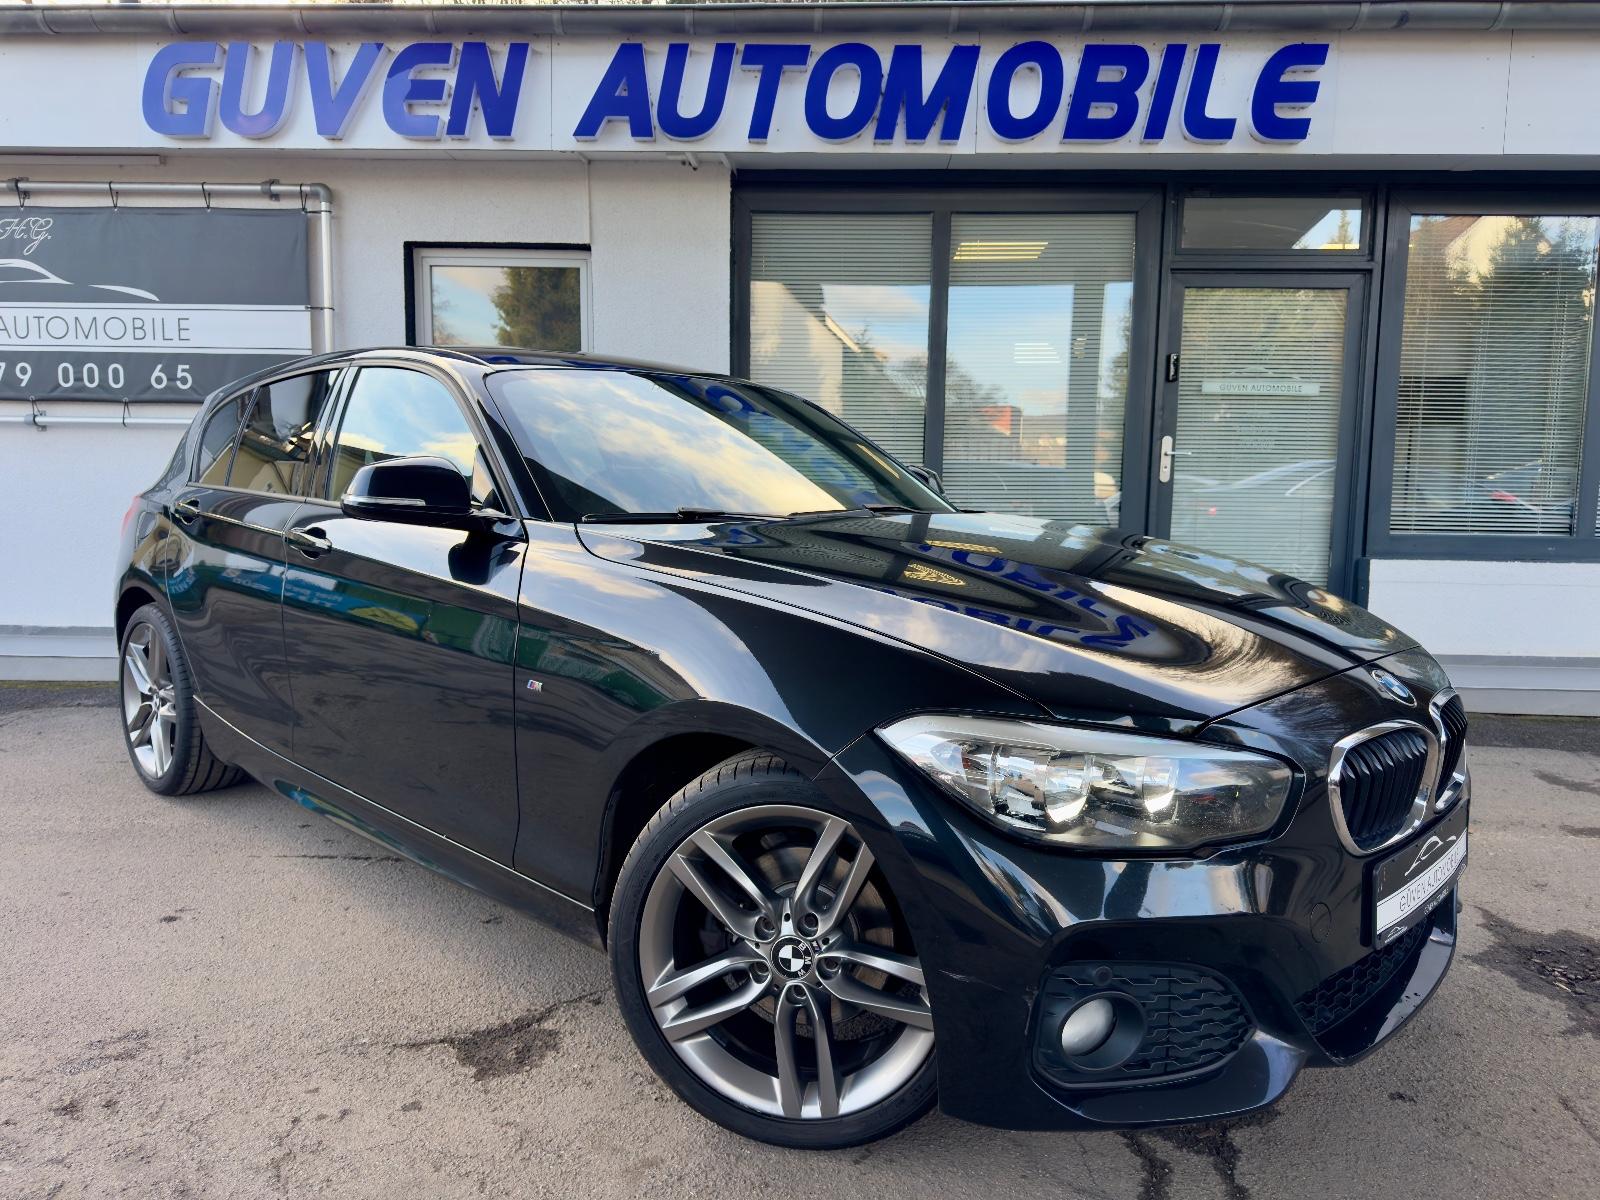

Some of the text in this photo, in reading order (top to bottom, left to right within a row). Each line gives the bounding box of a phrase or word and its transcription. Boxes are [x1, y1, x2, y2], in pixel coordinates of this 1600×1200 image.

[143, 40, 1330, 141] GUVEN AUTOMOBILE
[57, 362, 125, 389] 000
[150, 364, 193, 390] 65
[1250, 384, 1302, 393] AUTOMOBILE
